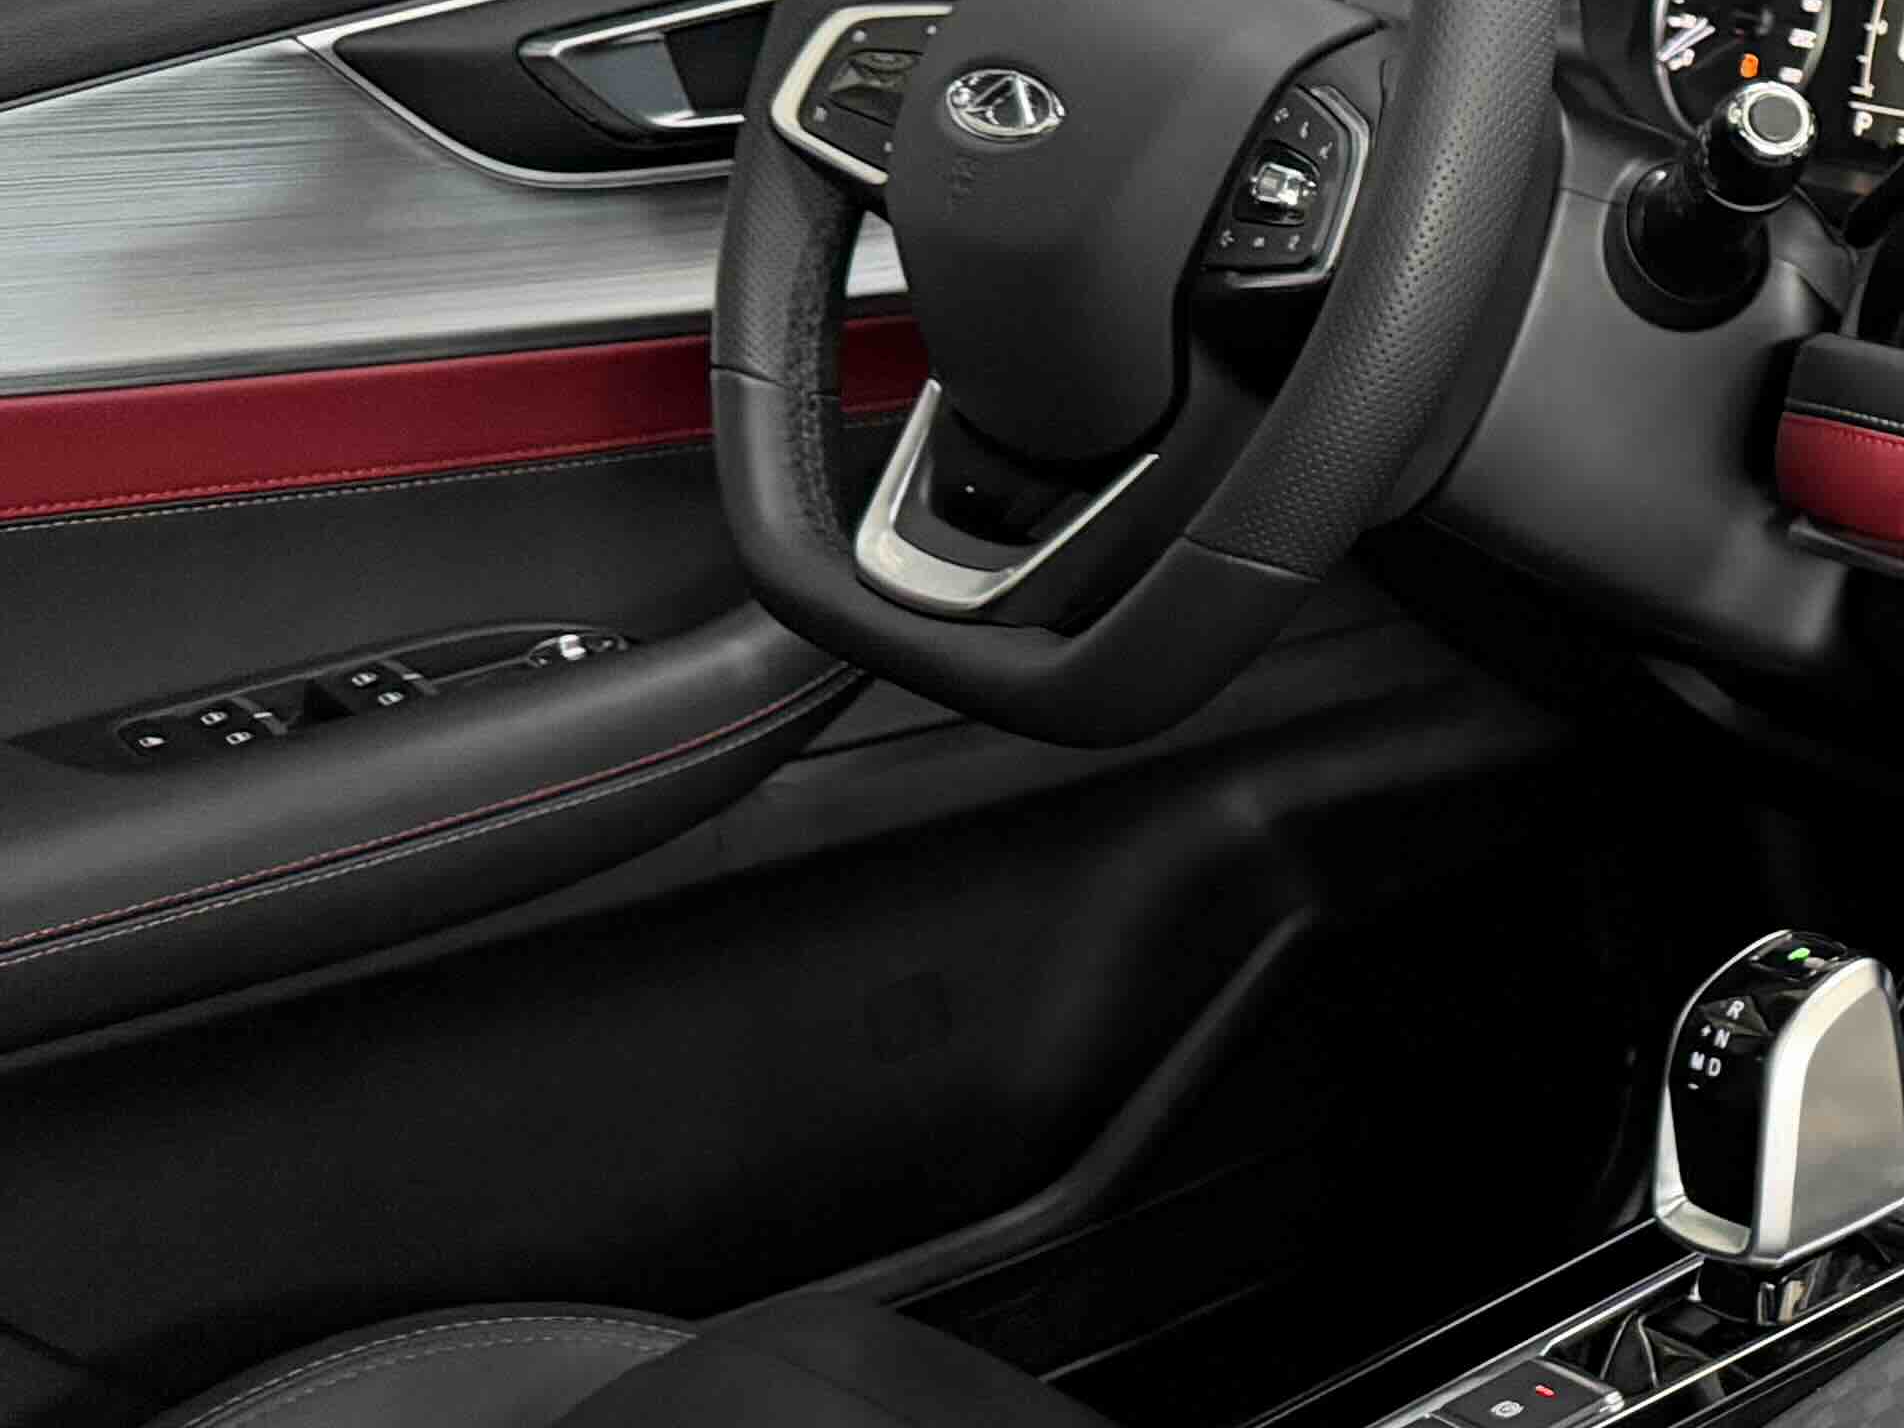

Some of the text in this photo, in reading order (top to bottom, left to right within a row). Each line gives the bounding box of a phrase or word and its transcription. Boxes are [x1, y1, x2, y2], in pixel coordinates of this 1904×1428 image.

[1726, 1000, 1744, 1019] R
[1713, 1029, 1730, 1049] N
[1690, 1052, 1704, 1071] M
[1708, 1057, 1722, 1077] D
